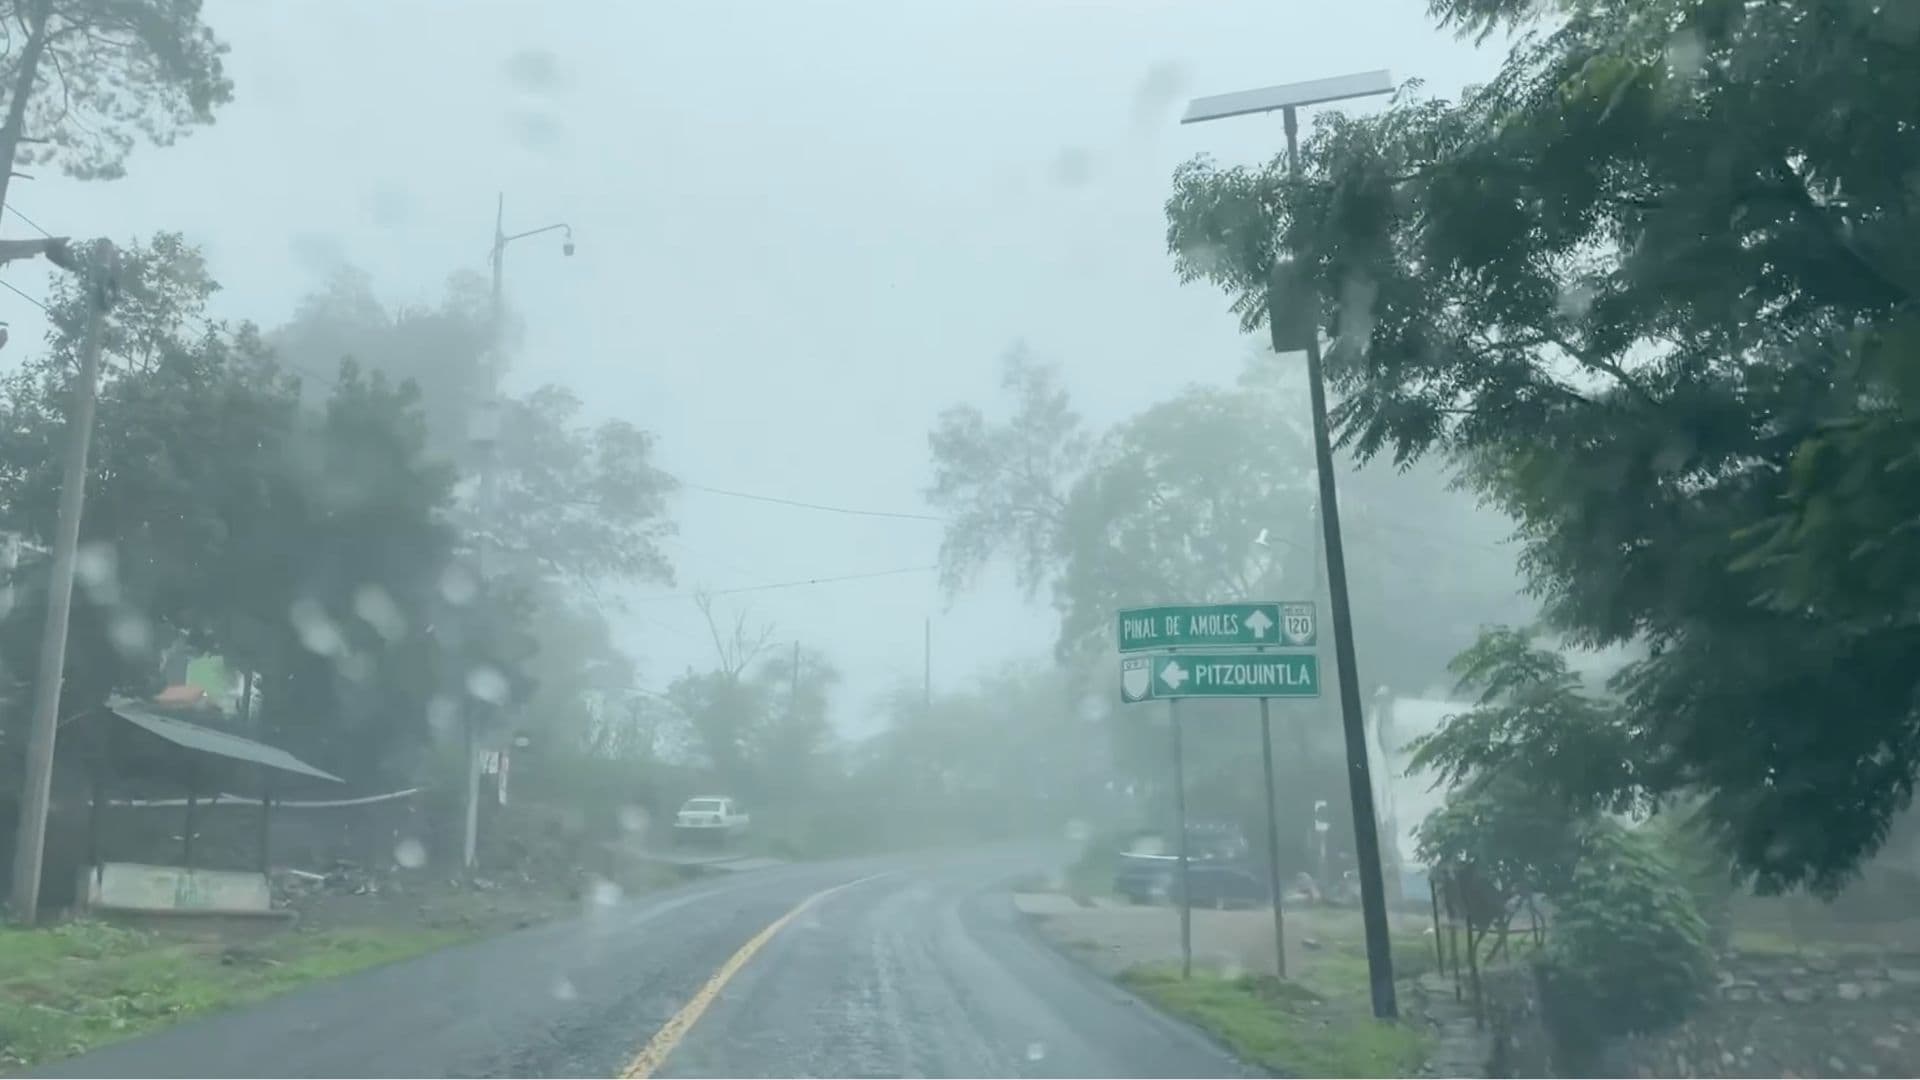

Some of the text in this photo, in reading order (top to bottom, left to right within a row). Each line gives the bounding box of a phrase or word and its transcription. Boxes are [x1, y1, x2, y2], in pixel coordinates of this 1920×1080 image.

[1124, 614, 1239, 641] PINAL DE AMOLES
[1288, 617, 1309, 634] 120
[1195, 664, 1311, 686] PITZQUINTLA
